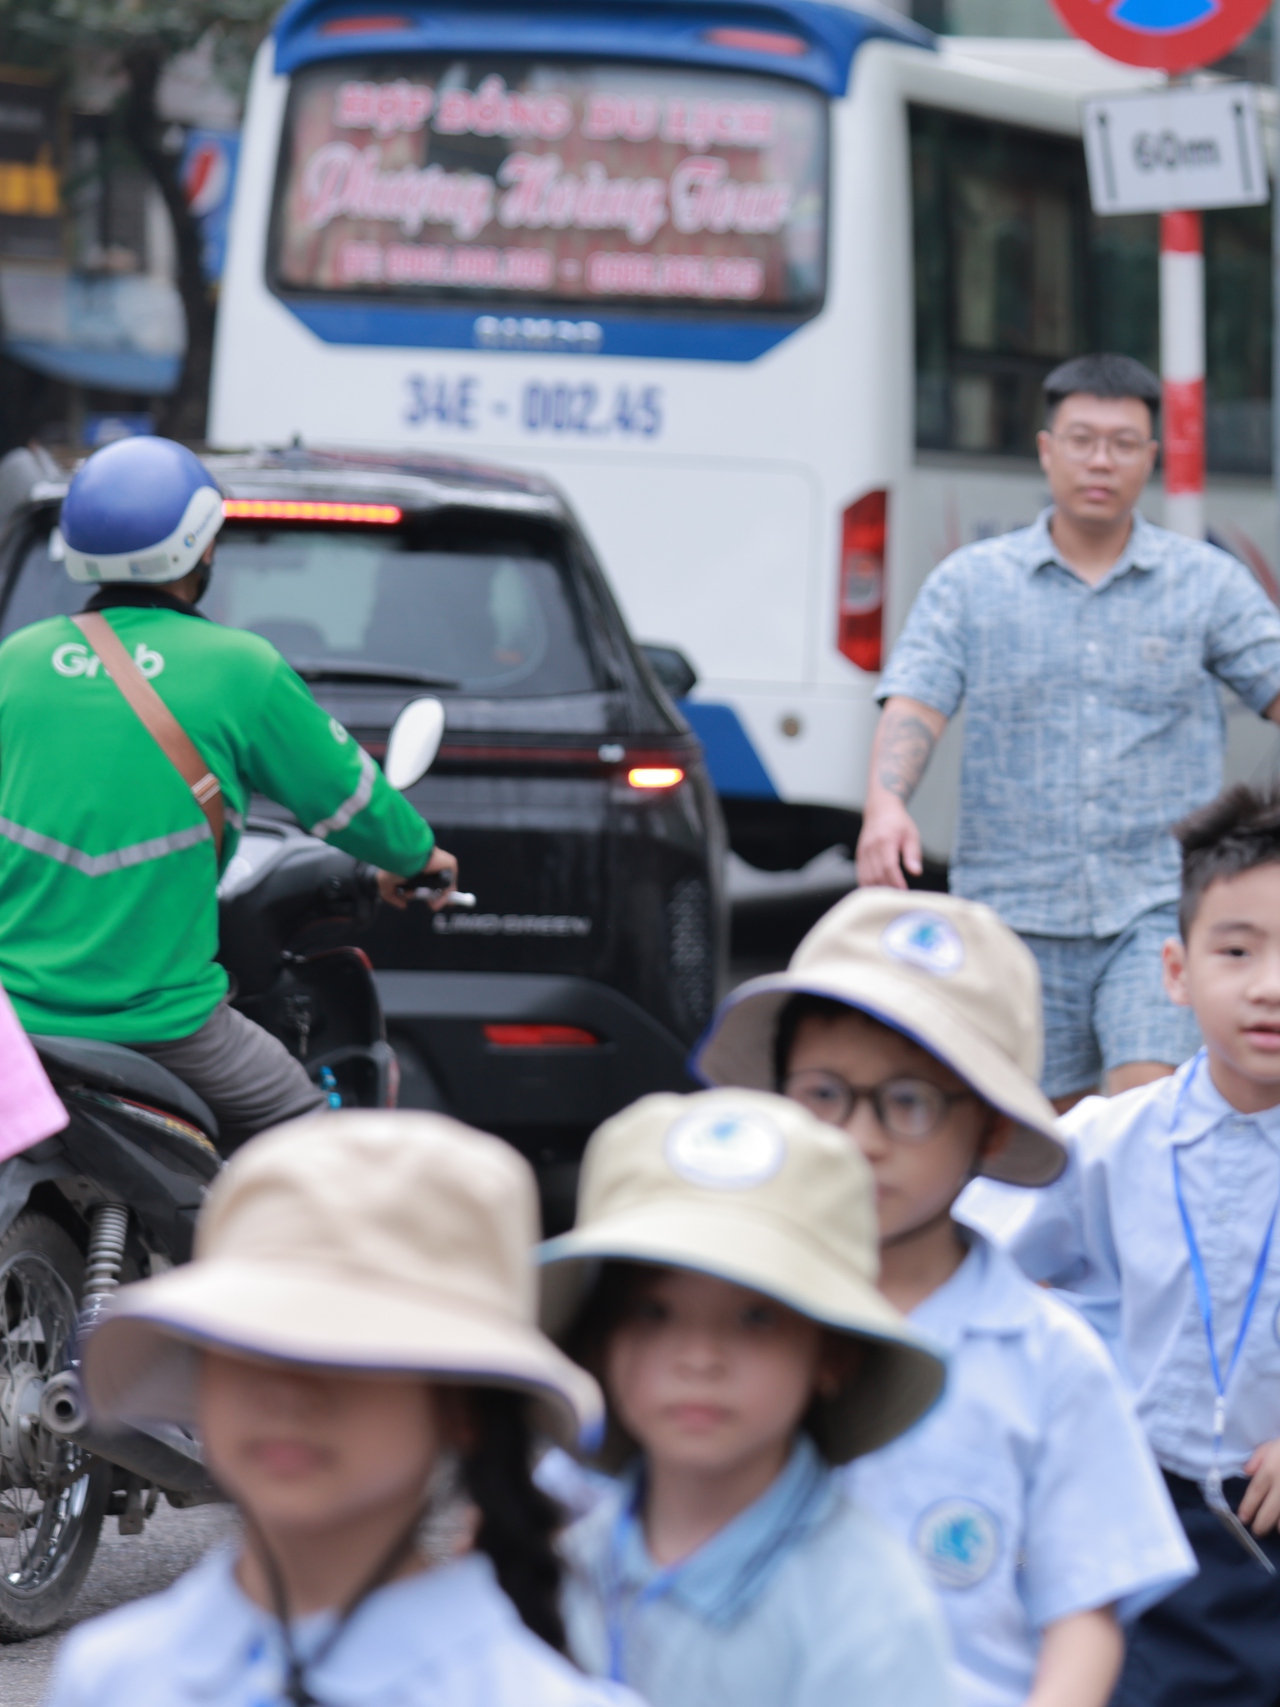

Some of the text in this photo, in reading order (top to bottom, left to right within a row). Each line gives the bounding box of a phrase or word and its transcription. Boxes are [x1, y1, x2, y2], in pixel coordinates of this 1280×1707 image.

[1134, 132, 1219, 172] 60m
[407, 374, 479, 429] 34E
[52, 643, 164, 679] Grb
